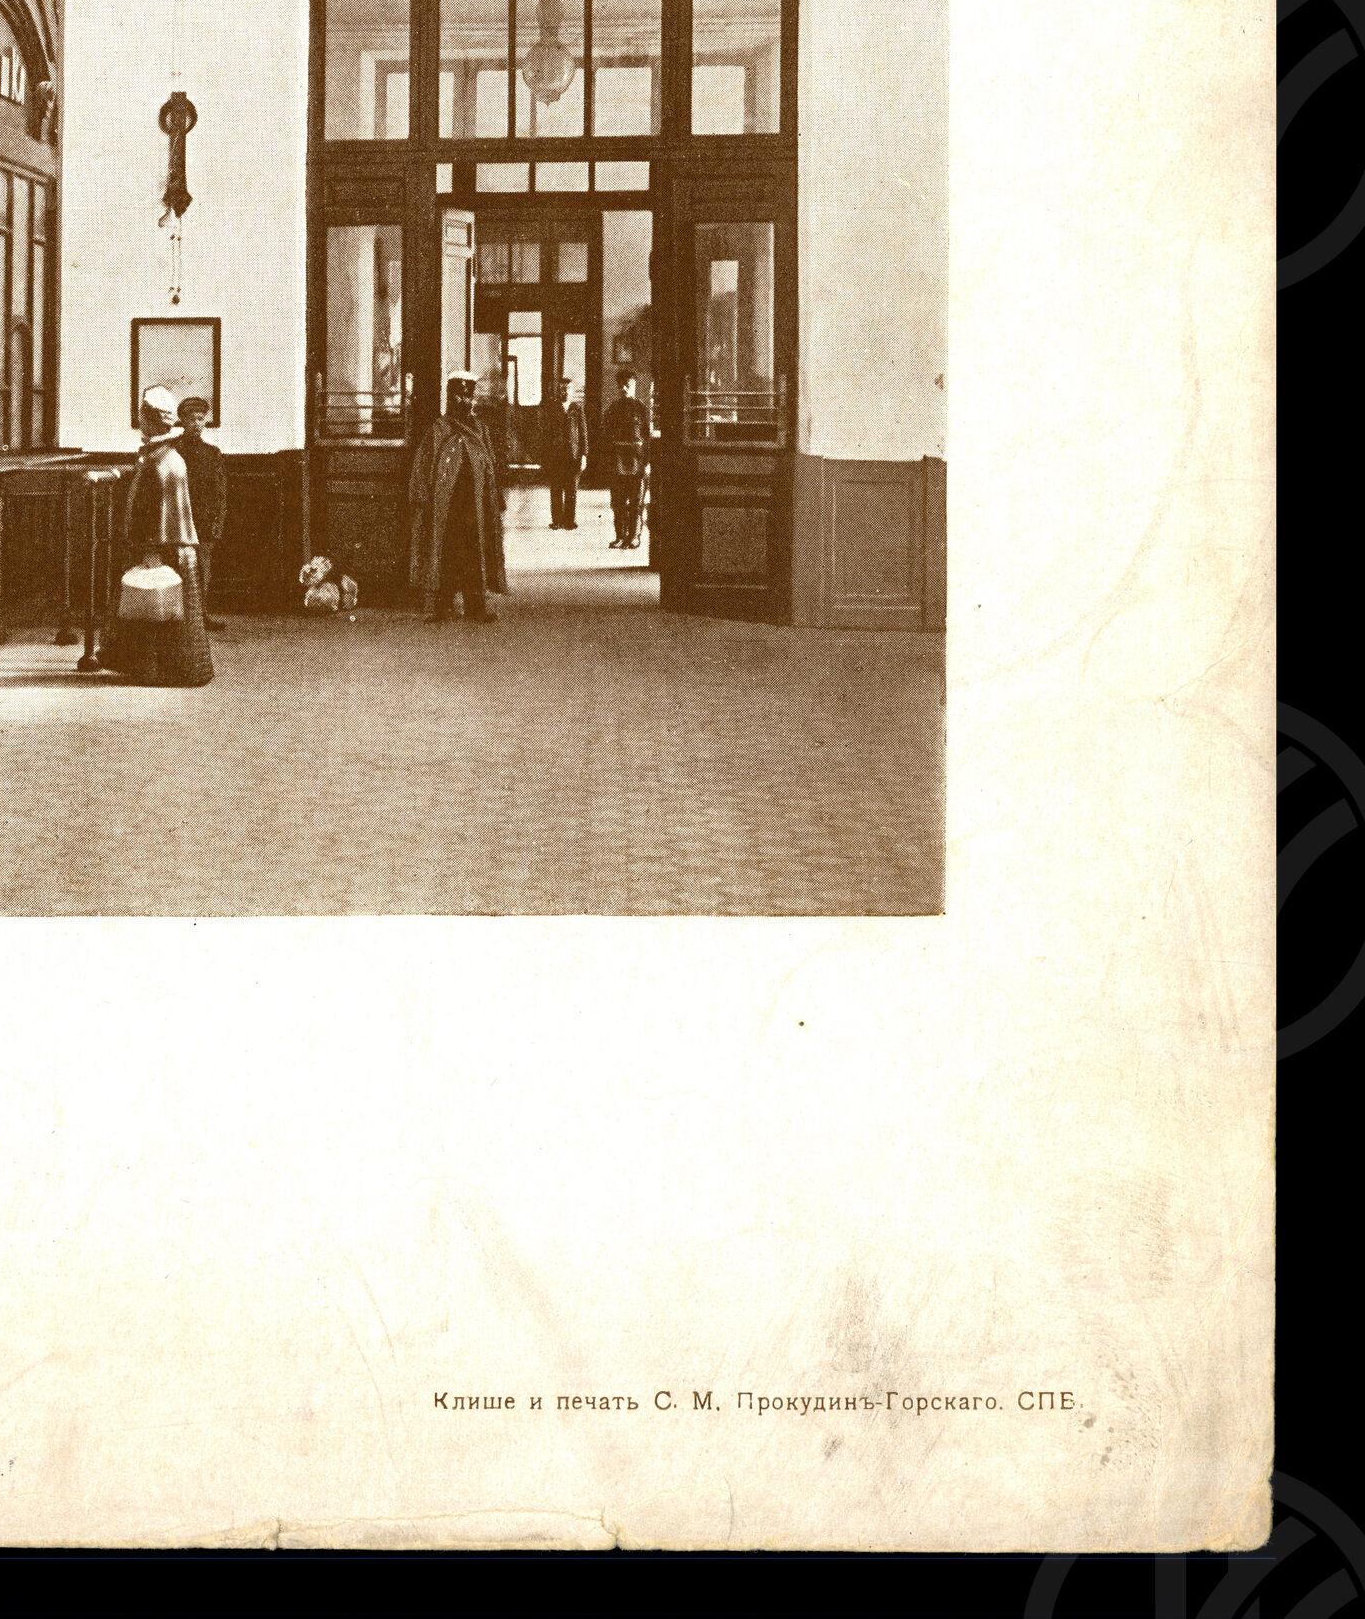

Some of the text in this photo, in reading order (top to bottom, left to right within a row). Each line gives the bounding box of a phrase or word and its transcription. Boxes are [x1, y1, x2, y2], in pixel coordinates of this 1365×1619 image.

[434, 1392, 515, 1410] Клише
[530, 1397, 542, 1410] и
[557, 1396, 639, 1410] печать
[654, 1390, 677, 1411] С.
[693, 1391, 720, 1412] М.
[737, 1391, 1003, 1416] Прокудинъ-Горскаго.
